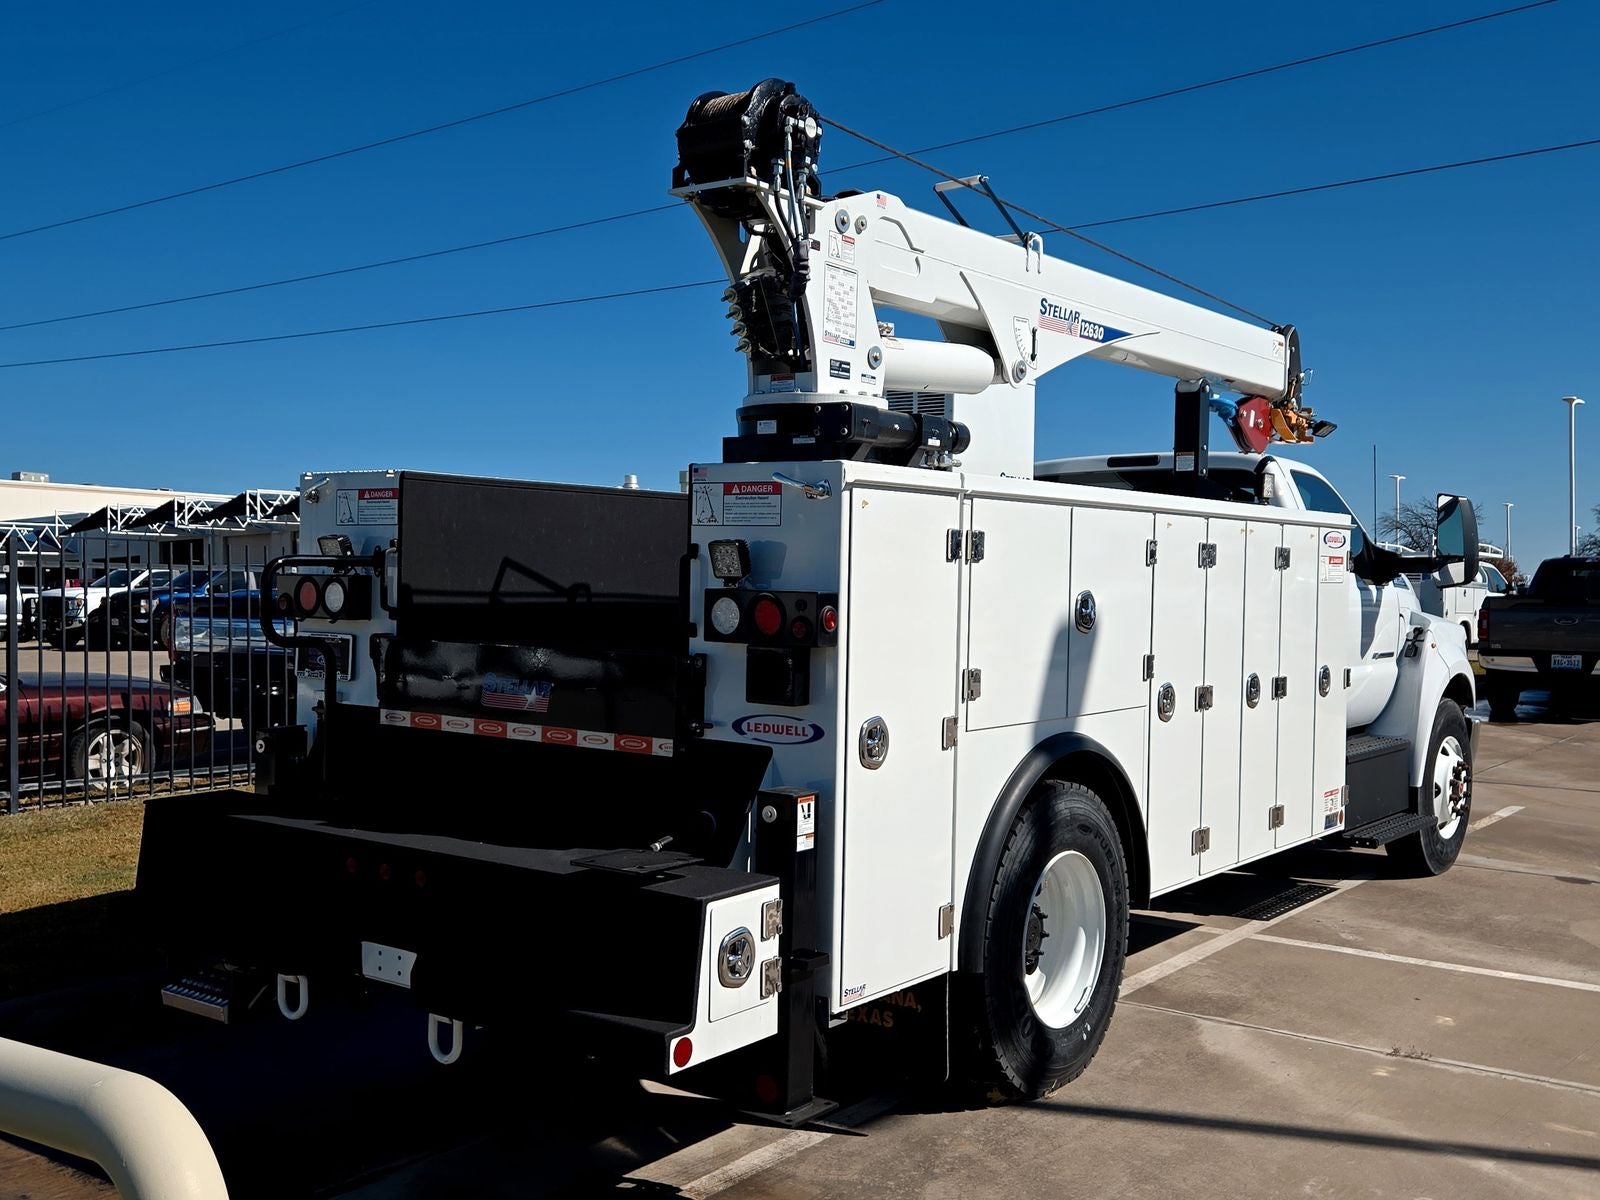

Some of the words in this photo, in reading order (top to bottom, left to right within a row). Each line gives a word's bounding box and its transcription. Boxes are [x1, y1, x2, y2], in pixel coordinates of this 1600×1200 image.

[1040, 297, 1080, 325] STELLAR
[1081, 321, 1104, 341] 12630
[370, 490, 393, 498] DANGER
[741, 484, 773, 493] DANGER
[483, 671, 552, 698] STELLAR
[746, 721, 809, 737] LEDWELL
[844, 983, 866, 997] STELLAR
